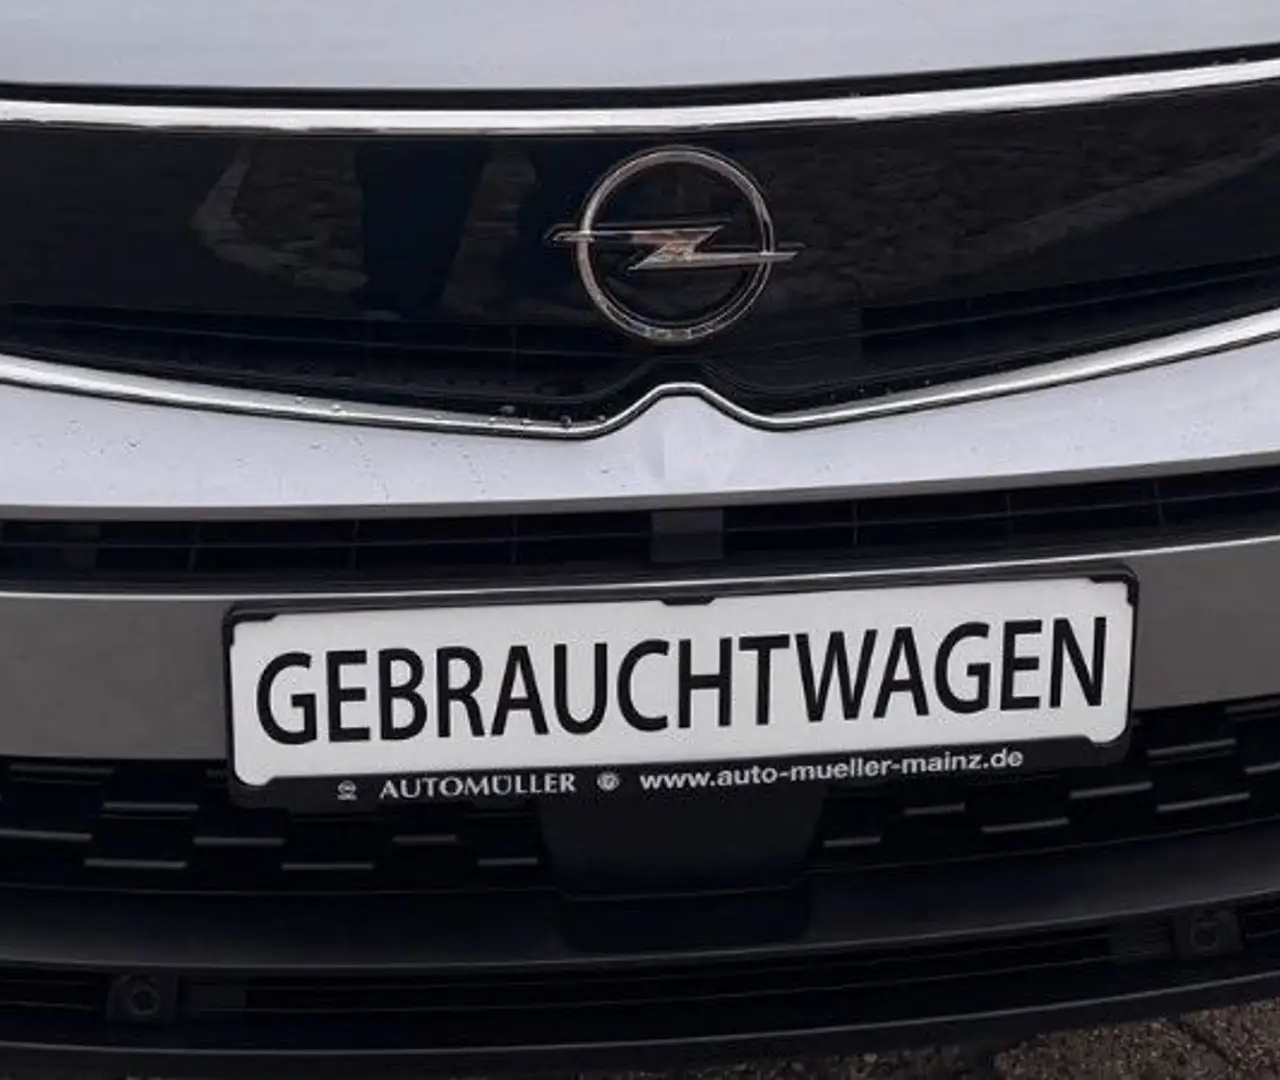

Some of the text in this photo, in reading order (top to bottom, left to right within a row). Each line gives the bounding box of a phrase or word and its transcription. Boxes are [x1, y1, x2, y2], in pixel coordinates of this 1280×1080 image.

[256, 616, 1106, 745] GEBRAUCHTWAGEN
[379, 747, 1024, 800] AUTOMÜLLER www.auto-mueller-mainz.de
